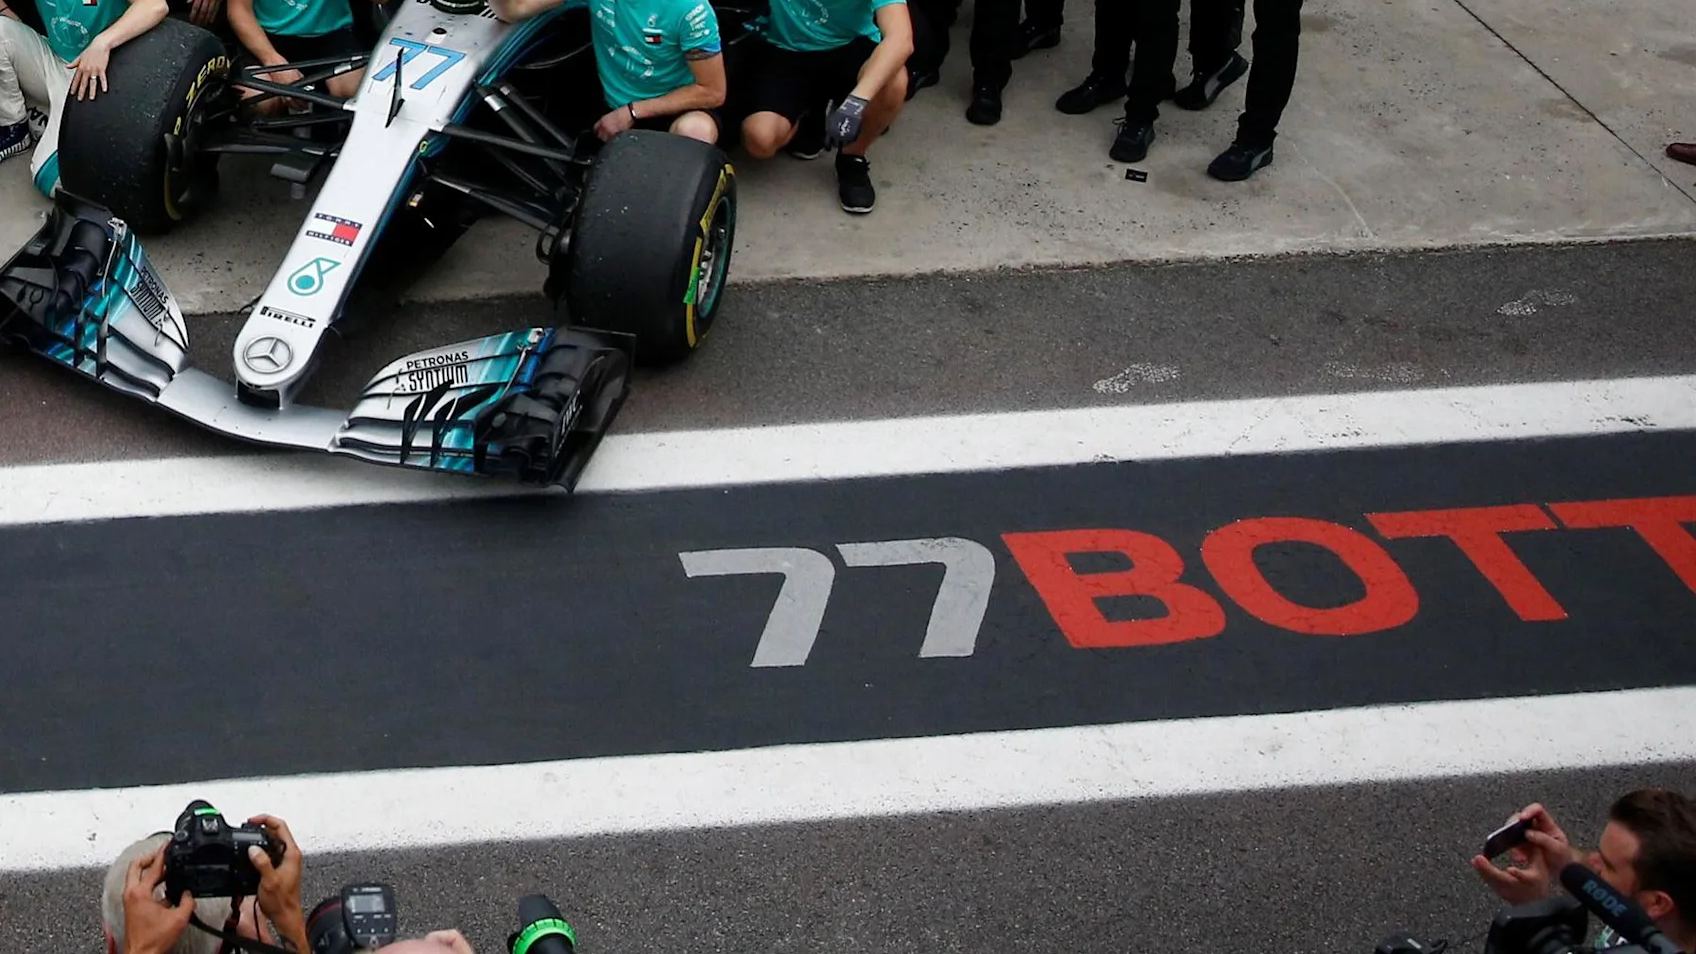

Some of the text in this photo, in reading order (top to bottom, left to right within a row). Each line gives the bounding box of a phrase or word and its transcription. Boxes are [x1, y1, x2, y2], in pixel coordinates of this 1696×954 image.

[371, 37, 467, 91] 77
[258, 305, 317, 330] PIRELLI
[406, 351, 469, 370] PETRONAS
[678, 536, 996, 669] 77
